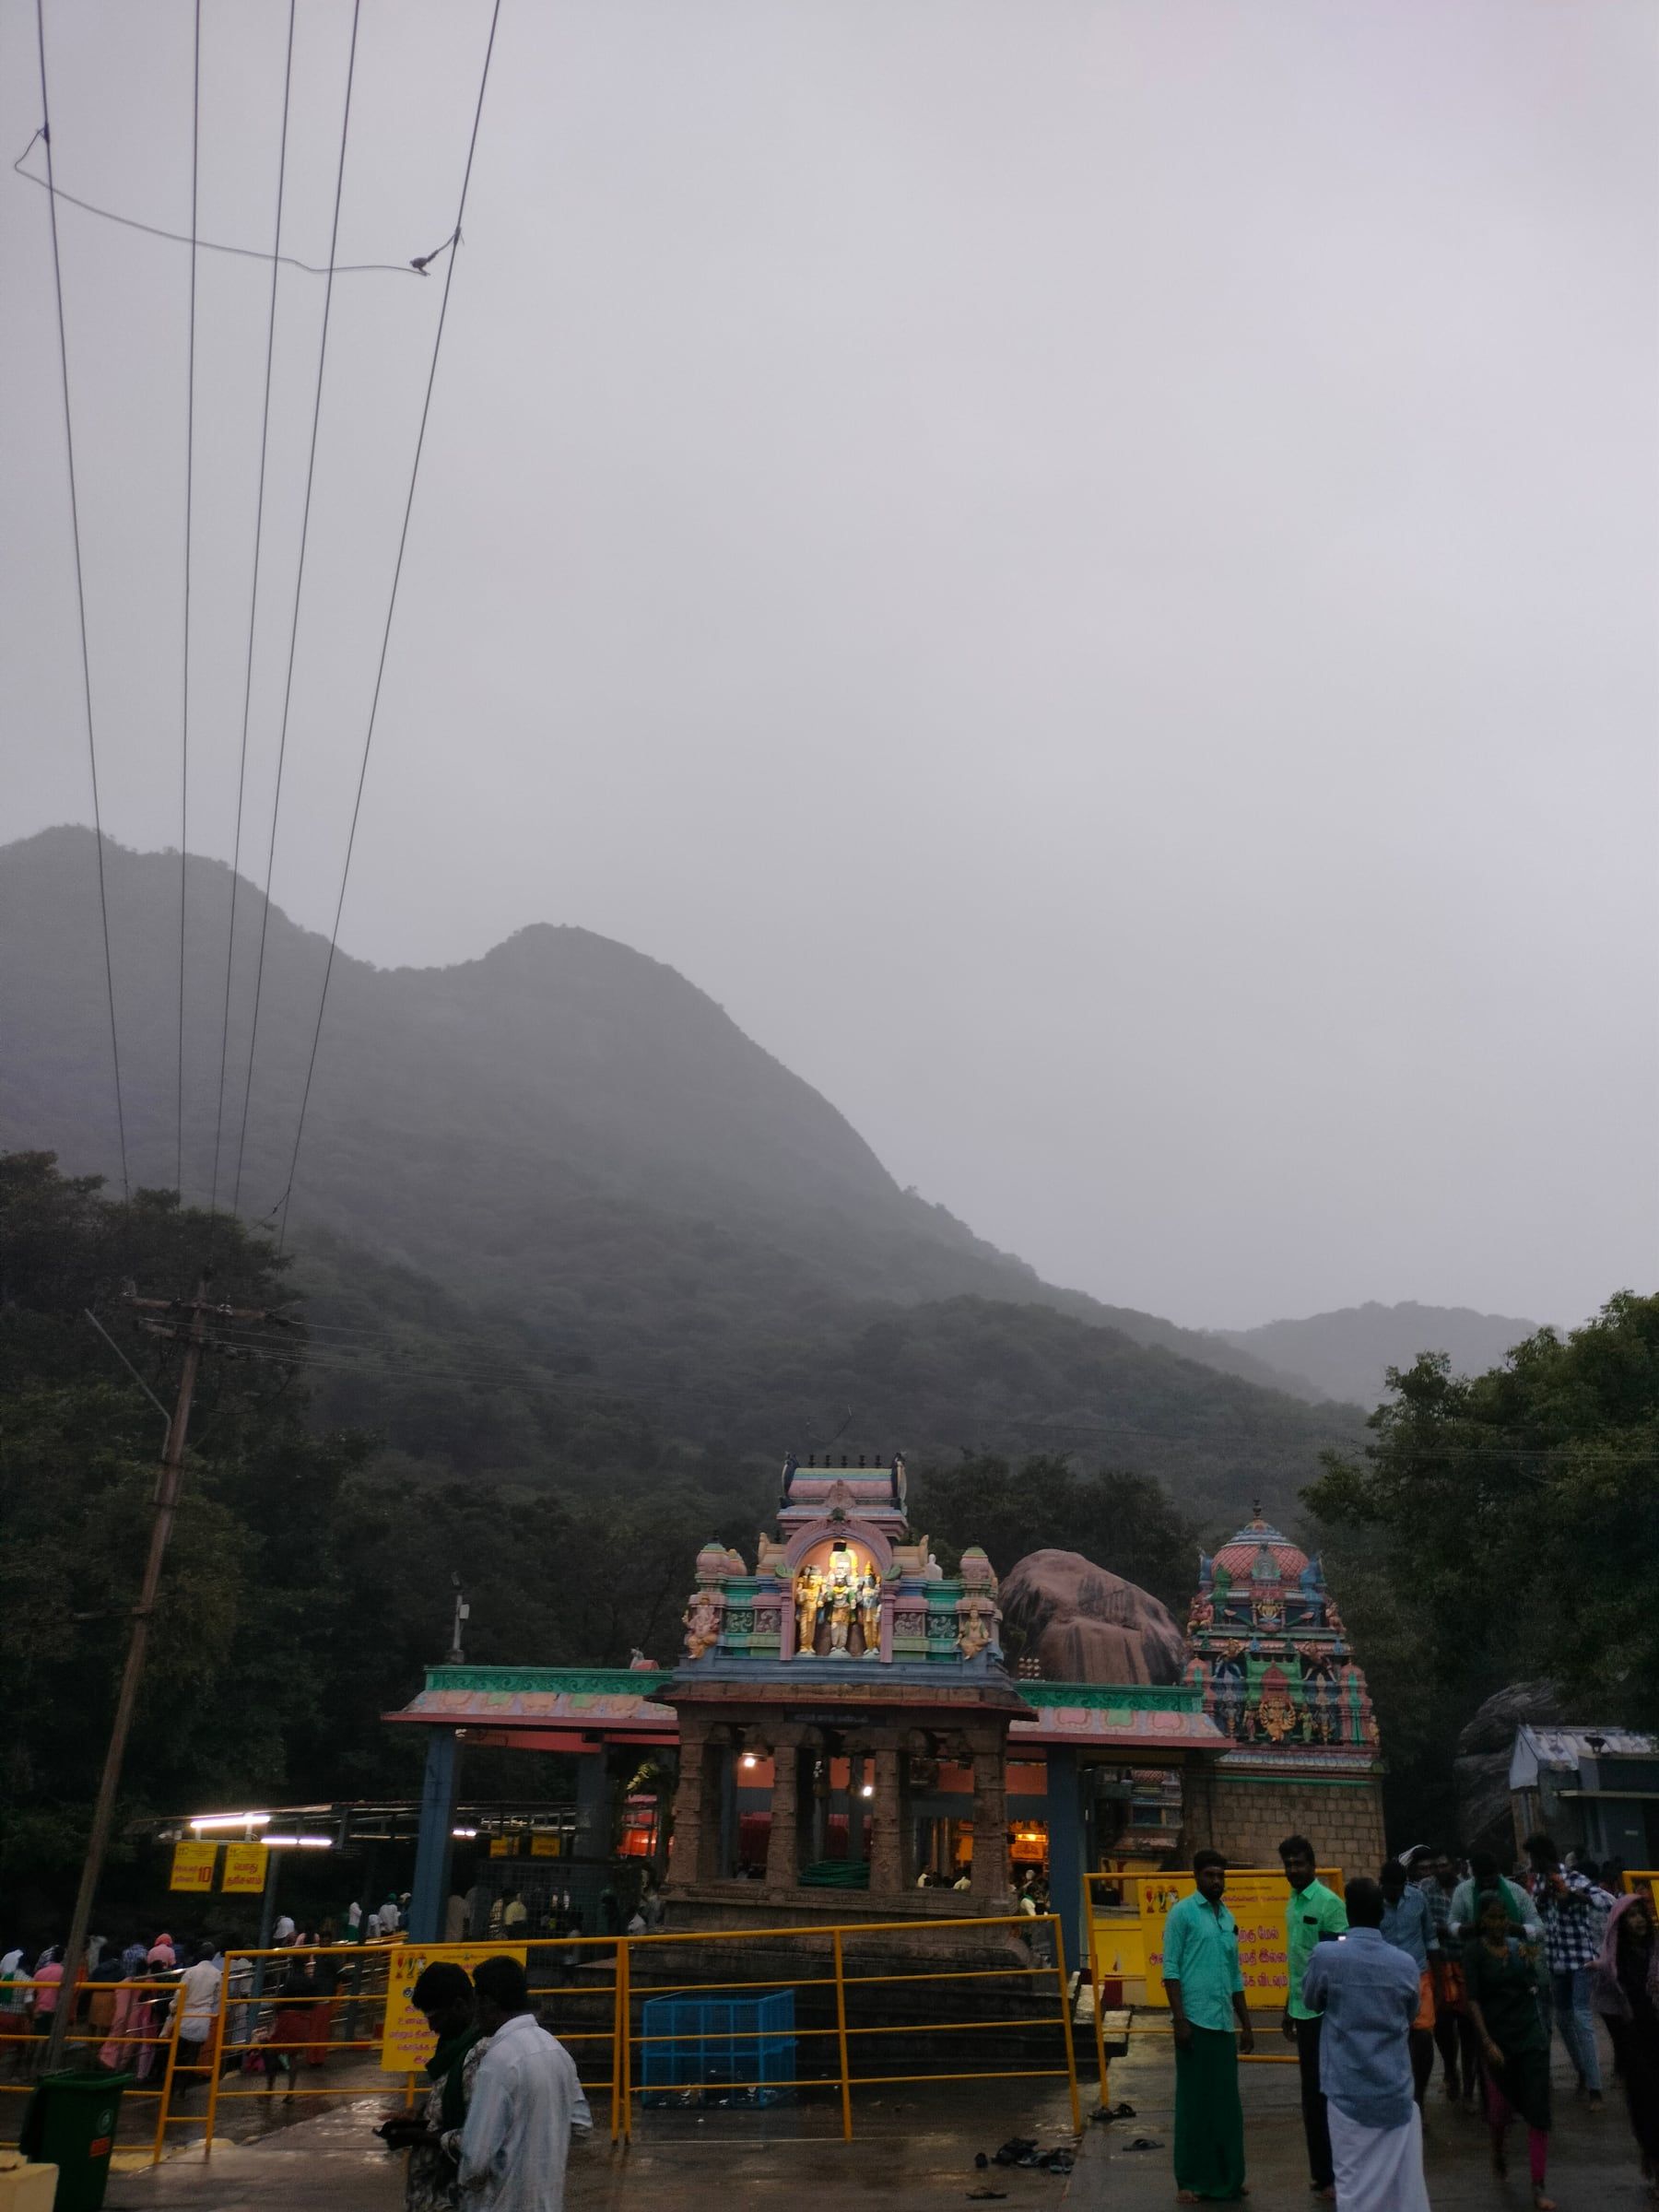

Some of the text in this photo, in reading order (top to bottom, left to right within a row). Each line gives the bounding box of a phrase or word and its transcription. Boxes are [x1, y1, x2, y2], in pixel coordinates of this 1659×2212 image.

[198, 1865, 212, 1882] 10
[1258, 1924, 1279, 1939] மேல்
[1257, 1971, 1288, 1988] விடவும்
